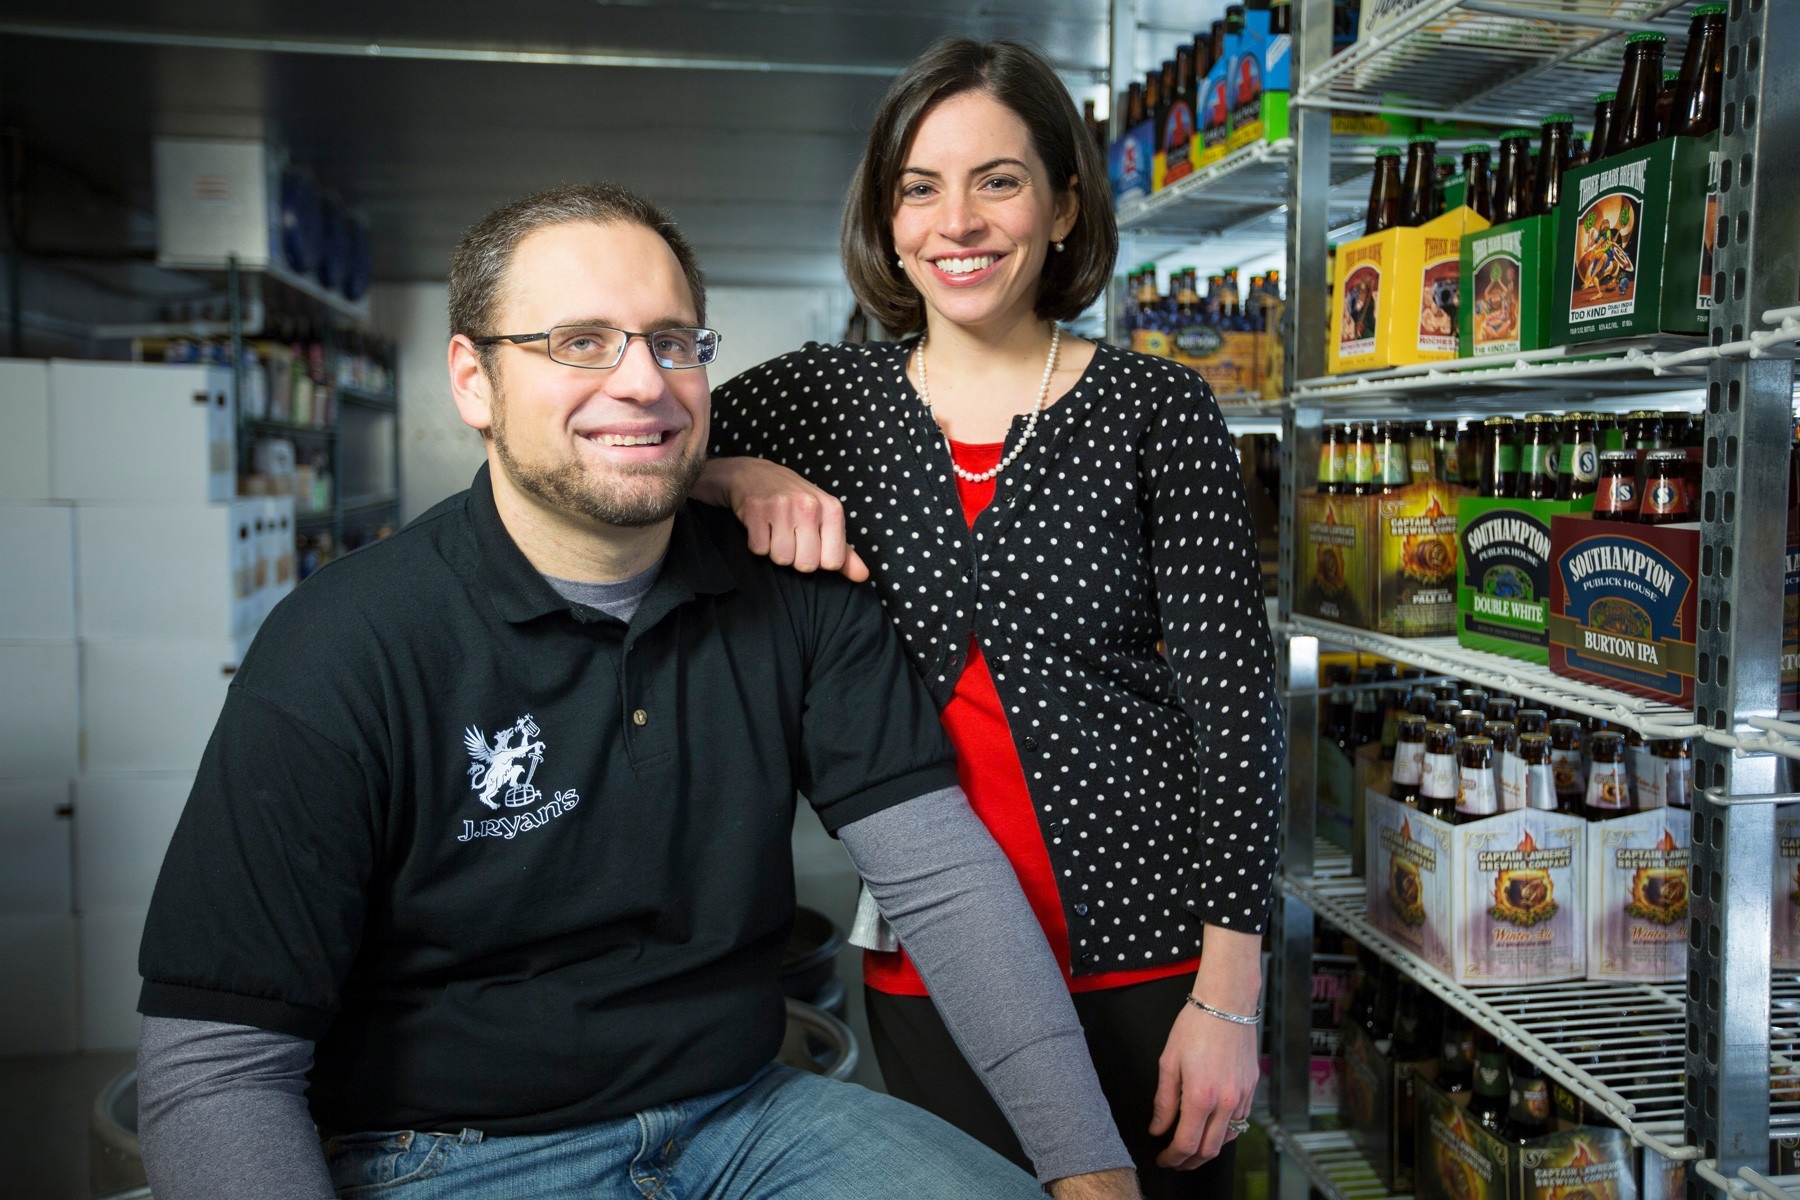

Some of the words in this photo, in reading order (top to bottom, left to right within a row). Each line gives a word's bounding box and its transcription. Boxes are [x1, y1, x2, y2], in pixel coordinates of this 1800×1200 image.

[1578, 173, 1600, 212] THREE
[1599, 167, 1620, 193] HEADS
[1619, 159, 1647, 195] BREWING
[1570, 310, 1585, 321] TOO
[1586, 306, 1607, 319] KIND
[1391, 517, 1430, 527] CAPTAIN
[1391, 526, 1434, 535] BREWING
[1467, 517, 1551, 562] SOUTHAMPTON
[1479, 546, 1511, 561] PUBLICK
[1511, 547, 1539, 567] HOUSE
[1568, 545, 1675, 598] SOUTHAMPTON
[1583, 576, 1622, 591] PUBLICK
[1623, 580, 1657, 602] HOUSE
[1473, 595, 1510, 616] DOUBLE
[1511, 601, 1544, 623] WHITE
[1584, 630, 1635, 659] BURTON
[1637, 642, 1659, 665] IPA
[1479, 851, 1524, 861] CAPTAIN
[1525, 847, 1571, 860] LAWRENCE
[1617, 850, 1662, 860] CAPTAIN
[1480, 860, 1527, 870] BREWING
[1528, 858, 1571, 869] COMPANY
[1617, 859, 1665, 869] BREWING
[1492, 927, 1533, 942] Winter
[1534, 926, 1555, 940] Ale
[1632, 925, 1671, 939] Winter
[1535, 1167, 1578, 1179] CAPTAIN
[1536, 1177, 1582, 1187] BREWING
